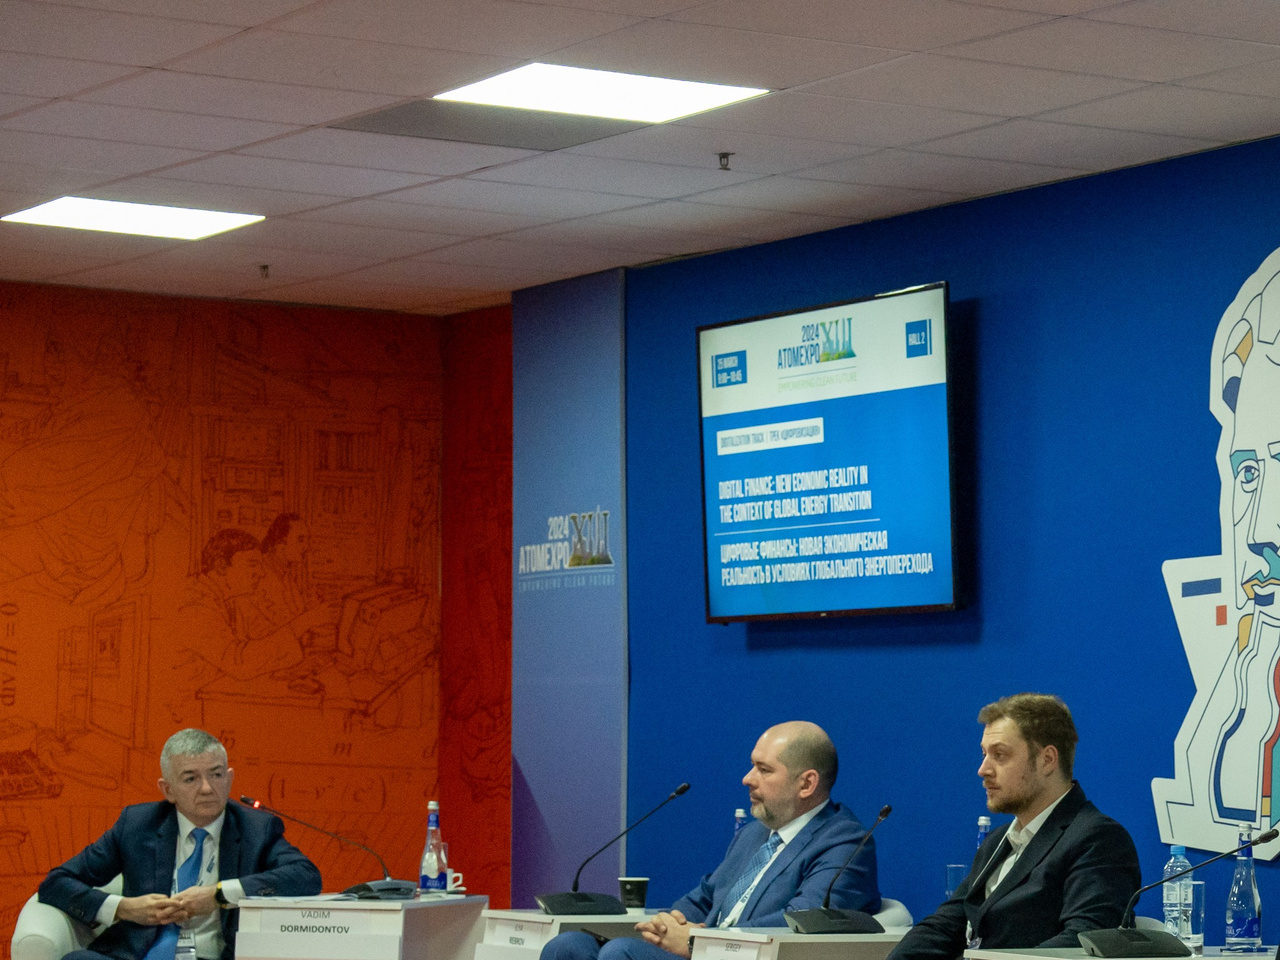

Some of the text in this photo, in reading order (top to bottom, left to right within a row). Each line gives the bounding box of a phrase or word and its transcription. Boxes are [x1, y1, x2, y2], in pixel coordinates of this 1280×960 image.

[801, 323, 819, 342] 2024
[777, 343, 820, 370] ATOMEXPO
[718, 479, 744, 500] DIGITAL
[775, 474, 792, 494] NEW
[792, 469, 829, 492] ECONOMIC
[829, 466, 858, 488] REALITY
[860, 465, 868, 485] IN
[719, 490, 872, 523] THE CONTEXT OF GLOBAL ENERGY TRANSITION
[518, 540, 570, 574] ATOMEXPO
[300, 910, 331, 919] VADIM
[280, 924, 350, 934] DORMIDONTOV
